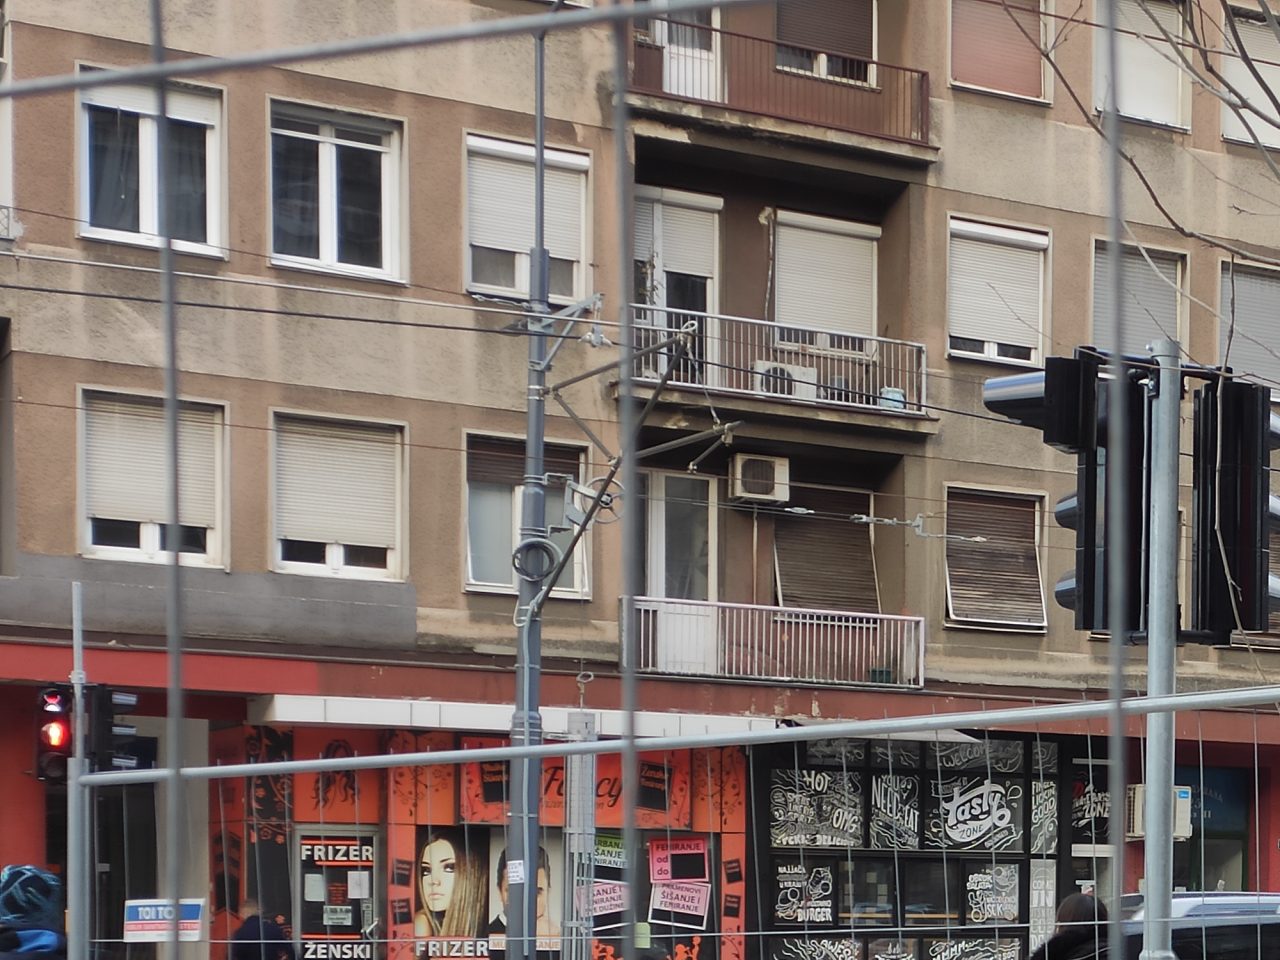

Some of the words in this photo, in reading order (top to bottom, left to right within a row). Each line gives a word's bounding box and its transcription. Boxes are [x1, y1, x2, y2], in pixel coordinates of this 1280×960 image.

[802, 769, 831, 794] HOT
[872, 775, 900, 820] NEED
[1032, 797, 1056, 823] GOOD
[832, 808, 858, 833] OMG
[904, 804, 919, 833] EAT
[960, 824, 984, 839] ZONE
[301, 845, 374, 861] FRIZER
[656, 855, 669, 864] od
[657, 867, 670, 875] do
[661, 889, 697, 903] ŠIŠANJE
[797, 908, 833, 922] BURGER
[304, 941, 371, 959] ŽENSKI
[415, 941, 489, 957] FRIZER
